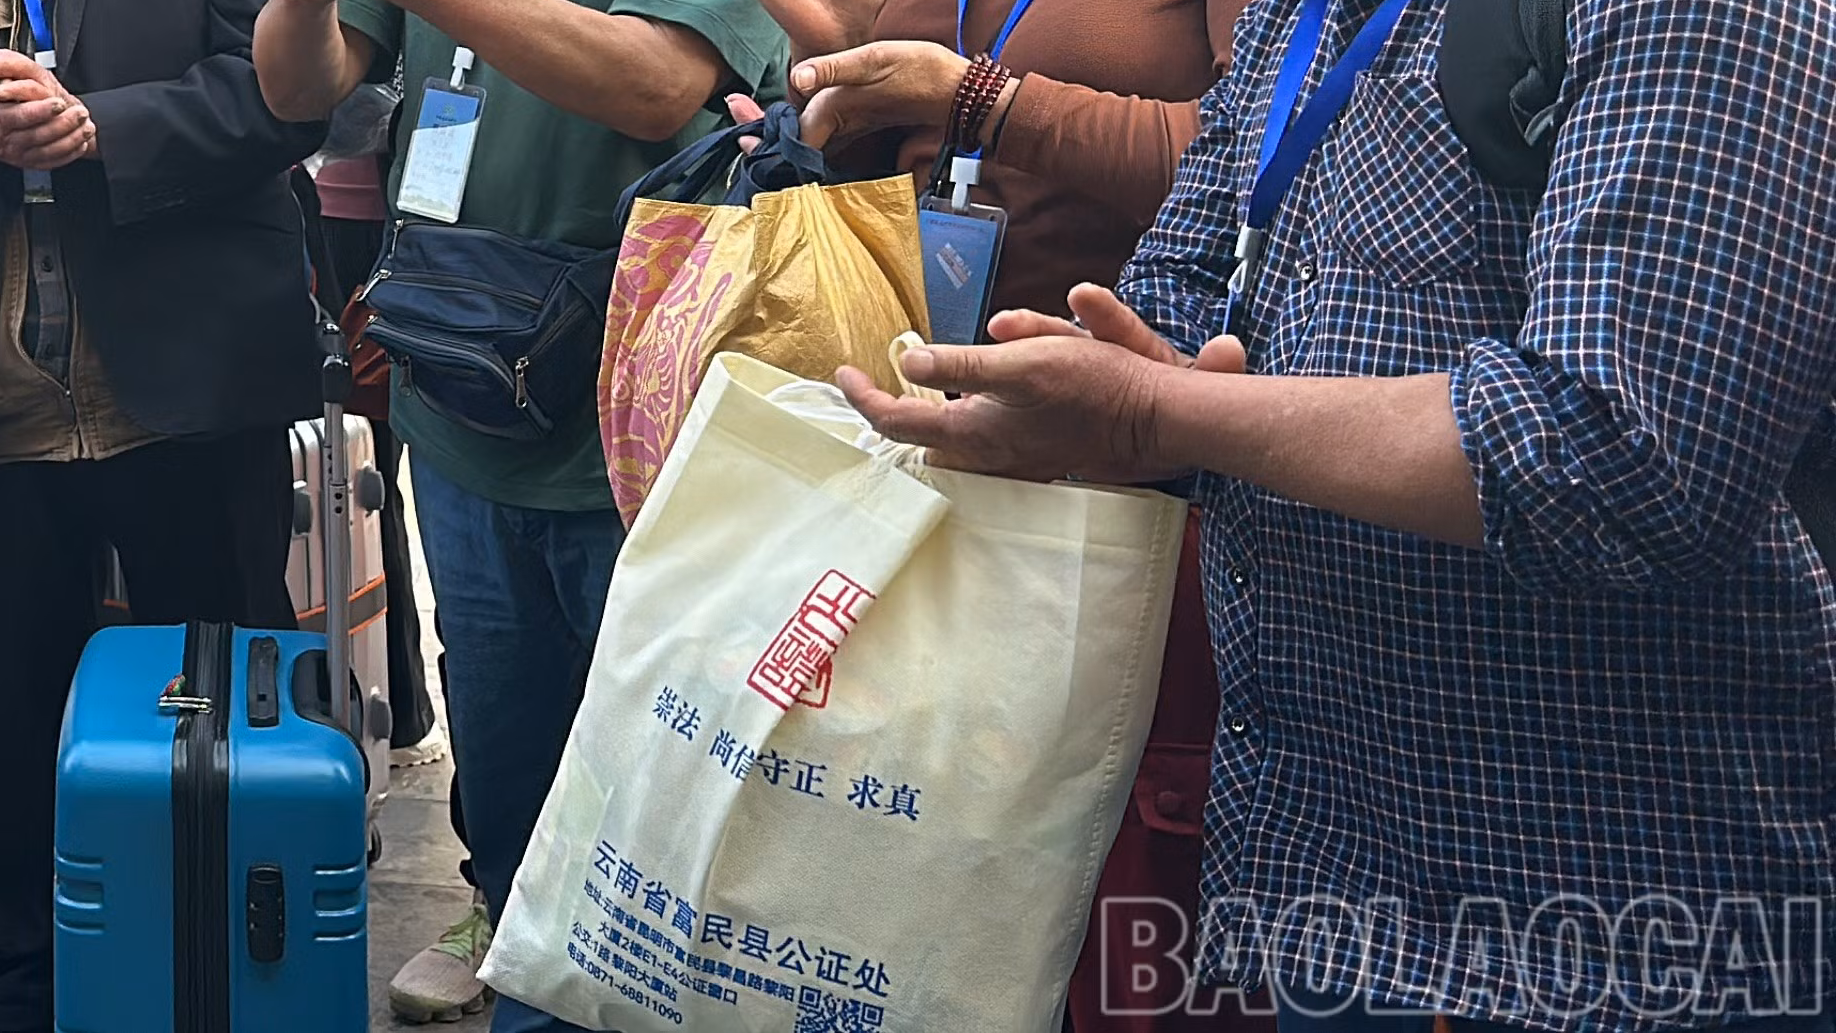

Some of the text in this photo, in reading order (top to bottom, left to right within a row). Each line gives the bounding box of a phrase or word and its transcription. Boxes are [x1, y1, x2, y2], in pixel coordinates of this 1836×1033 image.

[652, 684, 702, 742] 崇法
[846, 774, 922, 822] 求真
[593, 839, 891, 998] 云南省富民县公证处
